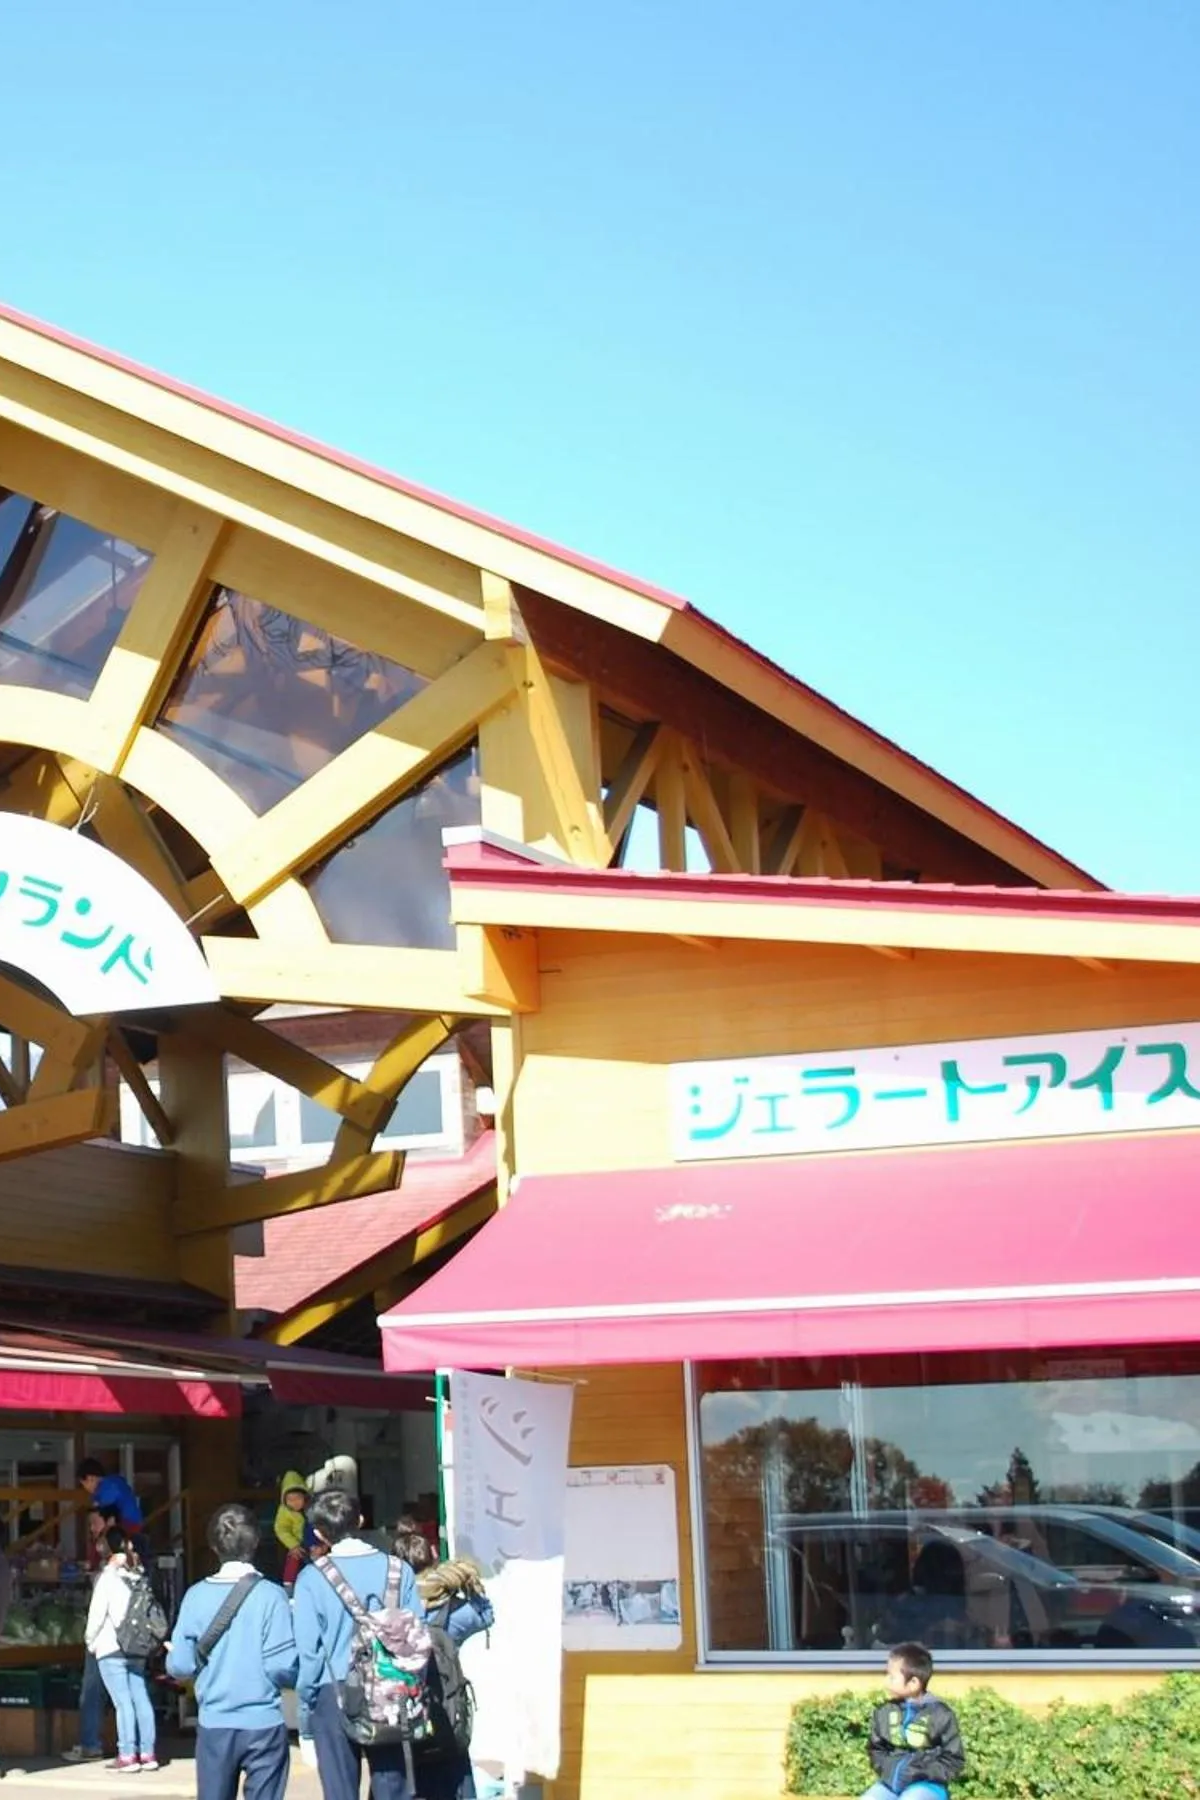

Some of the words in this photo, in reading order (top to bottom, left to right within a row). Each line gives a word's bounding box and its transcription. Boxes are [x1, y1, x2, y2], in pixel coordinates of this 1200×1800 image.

[690, 1042, 1200, 1141] ジェラートアイス
